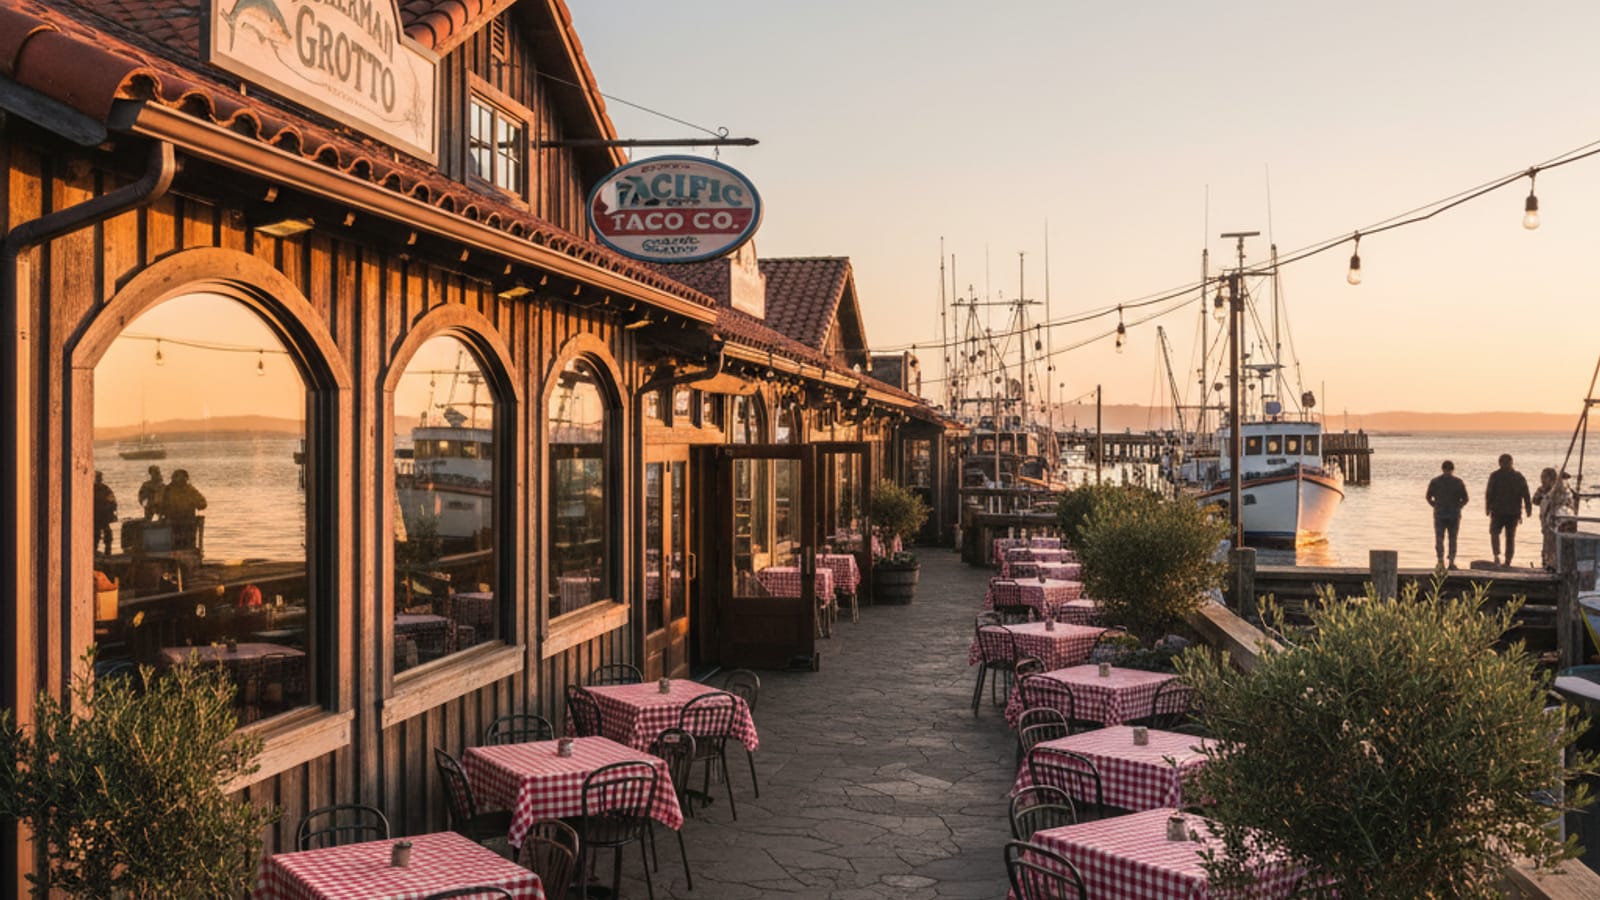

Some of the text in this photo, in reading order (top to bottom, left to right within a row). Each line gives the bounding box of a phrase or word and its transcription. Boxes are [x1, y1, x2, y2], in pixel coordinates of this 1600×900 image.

[296, 5, 396, 114] GROTTO
[612, 211, 740, 231] TACO CO.
